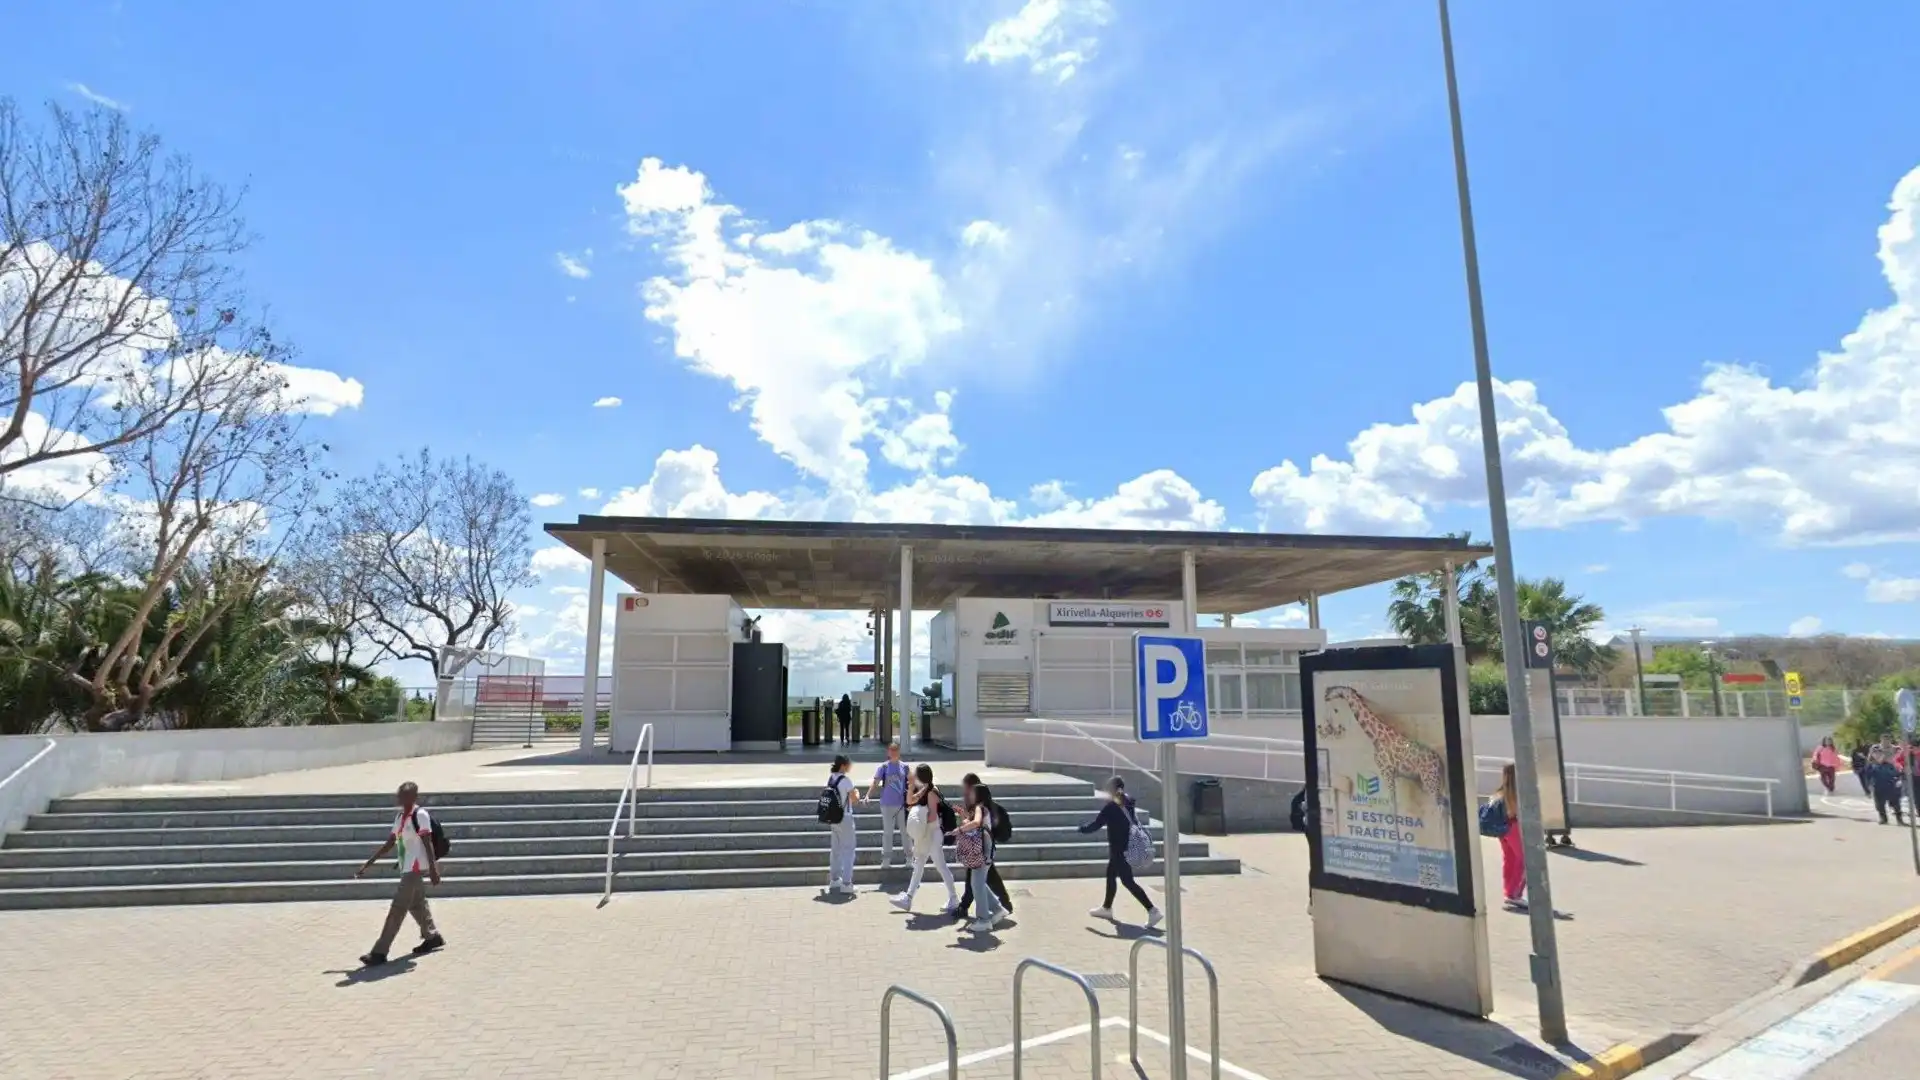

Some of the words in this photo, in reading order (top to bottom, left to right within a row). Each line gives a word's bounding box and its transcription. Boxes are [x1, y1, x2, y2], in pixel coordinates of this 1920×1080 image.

[1056, 607, 1144, 620] Xirivella-Alqueries
[1144, 644, 1188, 732] P
[1346, 810, 1358, 821] SI
[1362, 811, 1424, 828] ESTORBA
